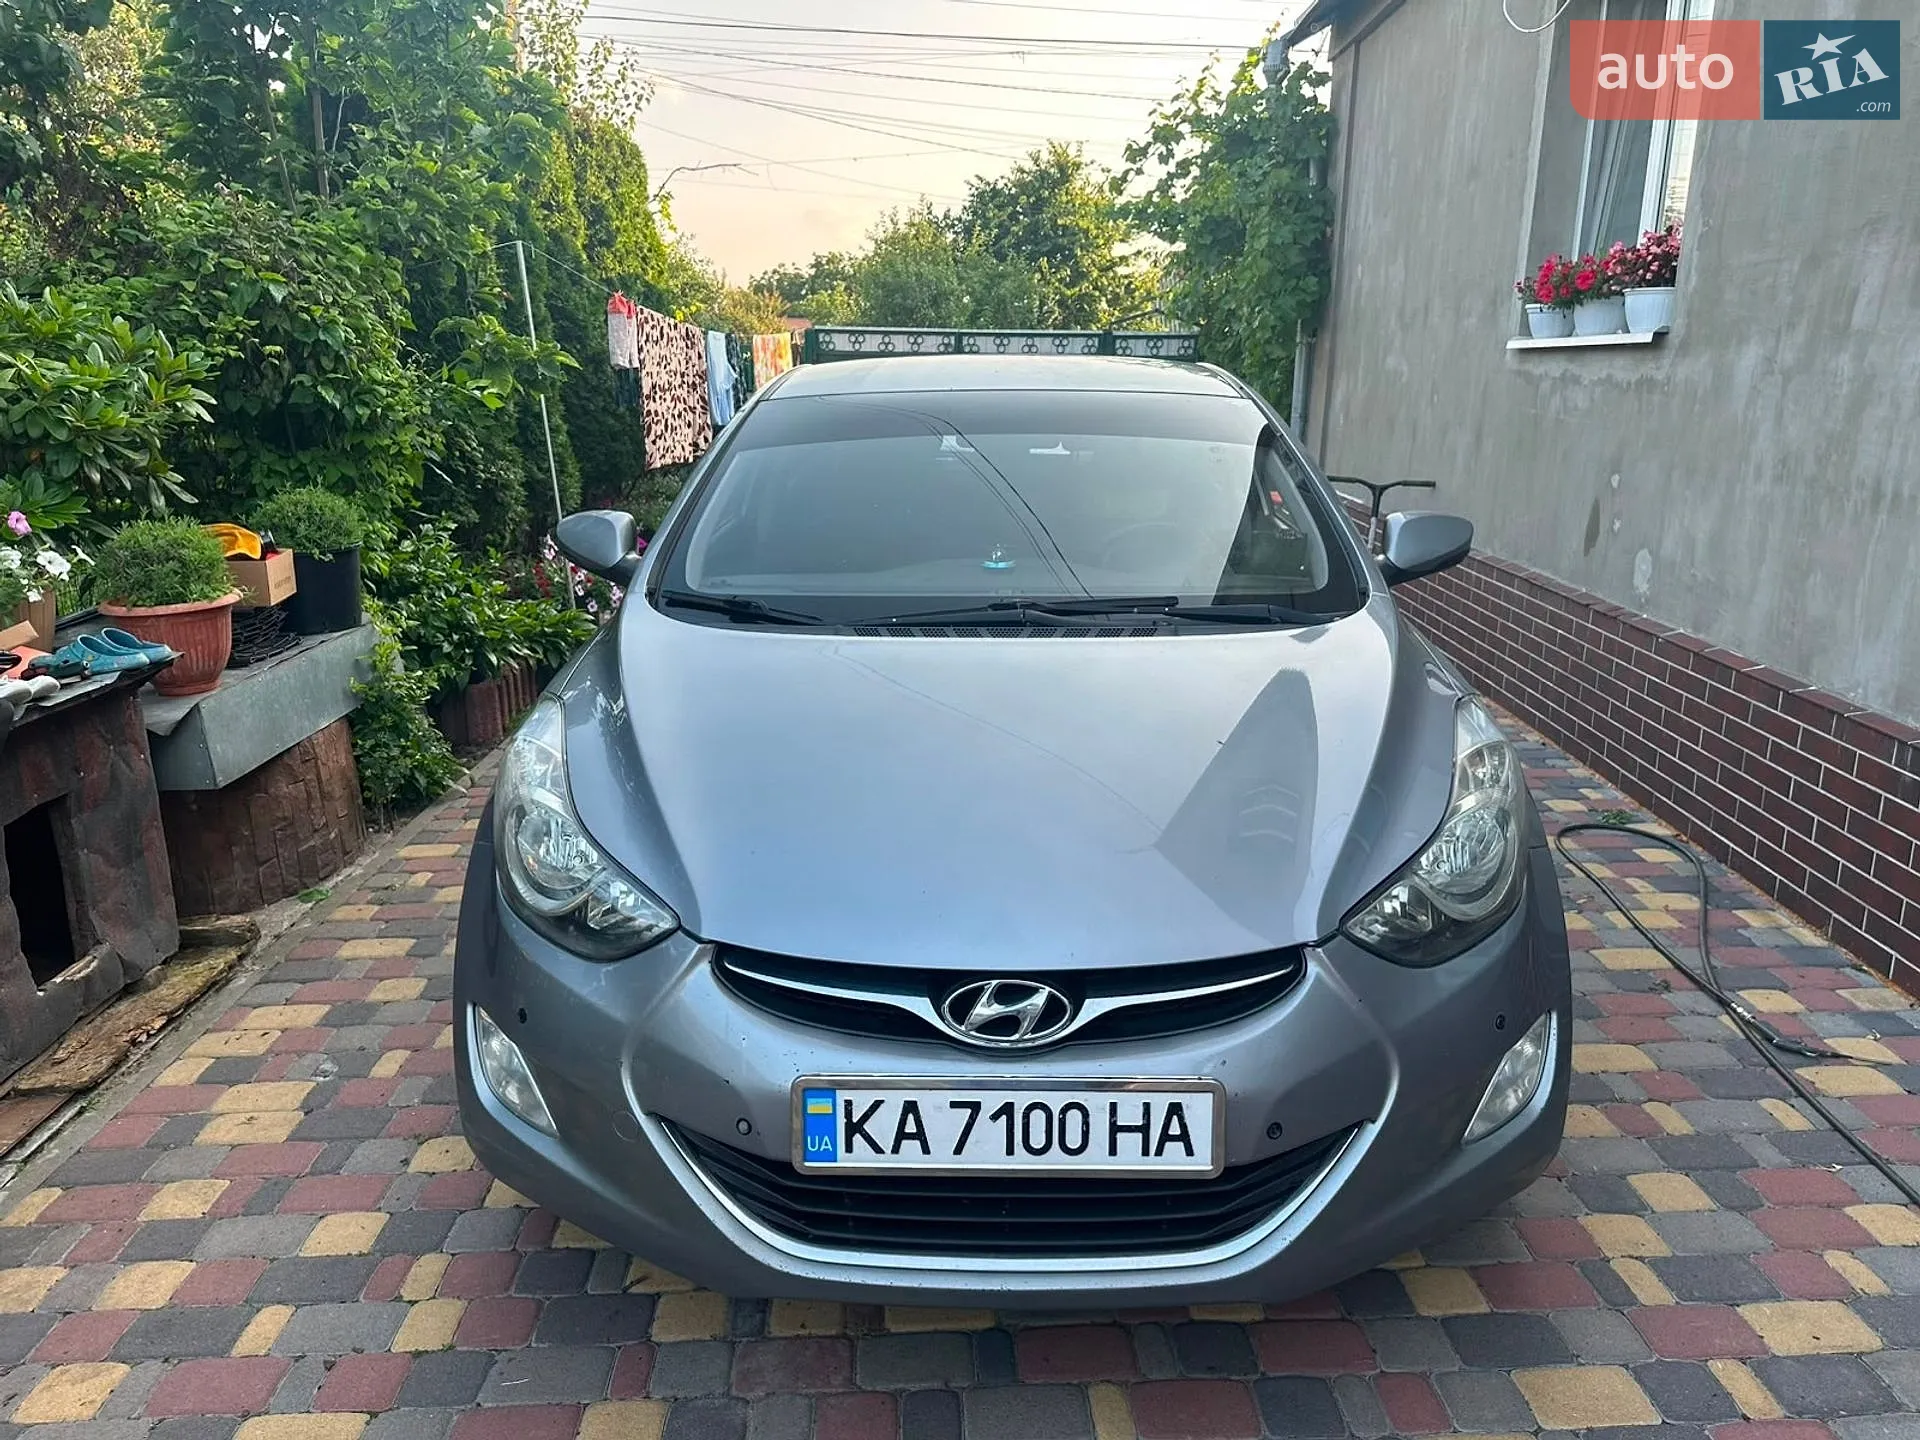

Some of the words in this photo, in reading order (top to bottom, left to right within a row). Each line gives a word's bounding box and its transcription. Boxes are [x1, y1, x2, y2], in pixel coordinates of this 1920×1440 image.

[807, 1135, 833, 1152] UA
[843, 1098, 931, 1156] KA
[949, 1100, 1090, 1157] 7100
[1108, 1101, 1195, 1158] HA
